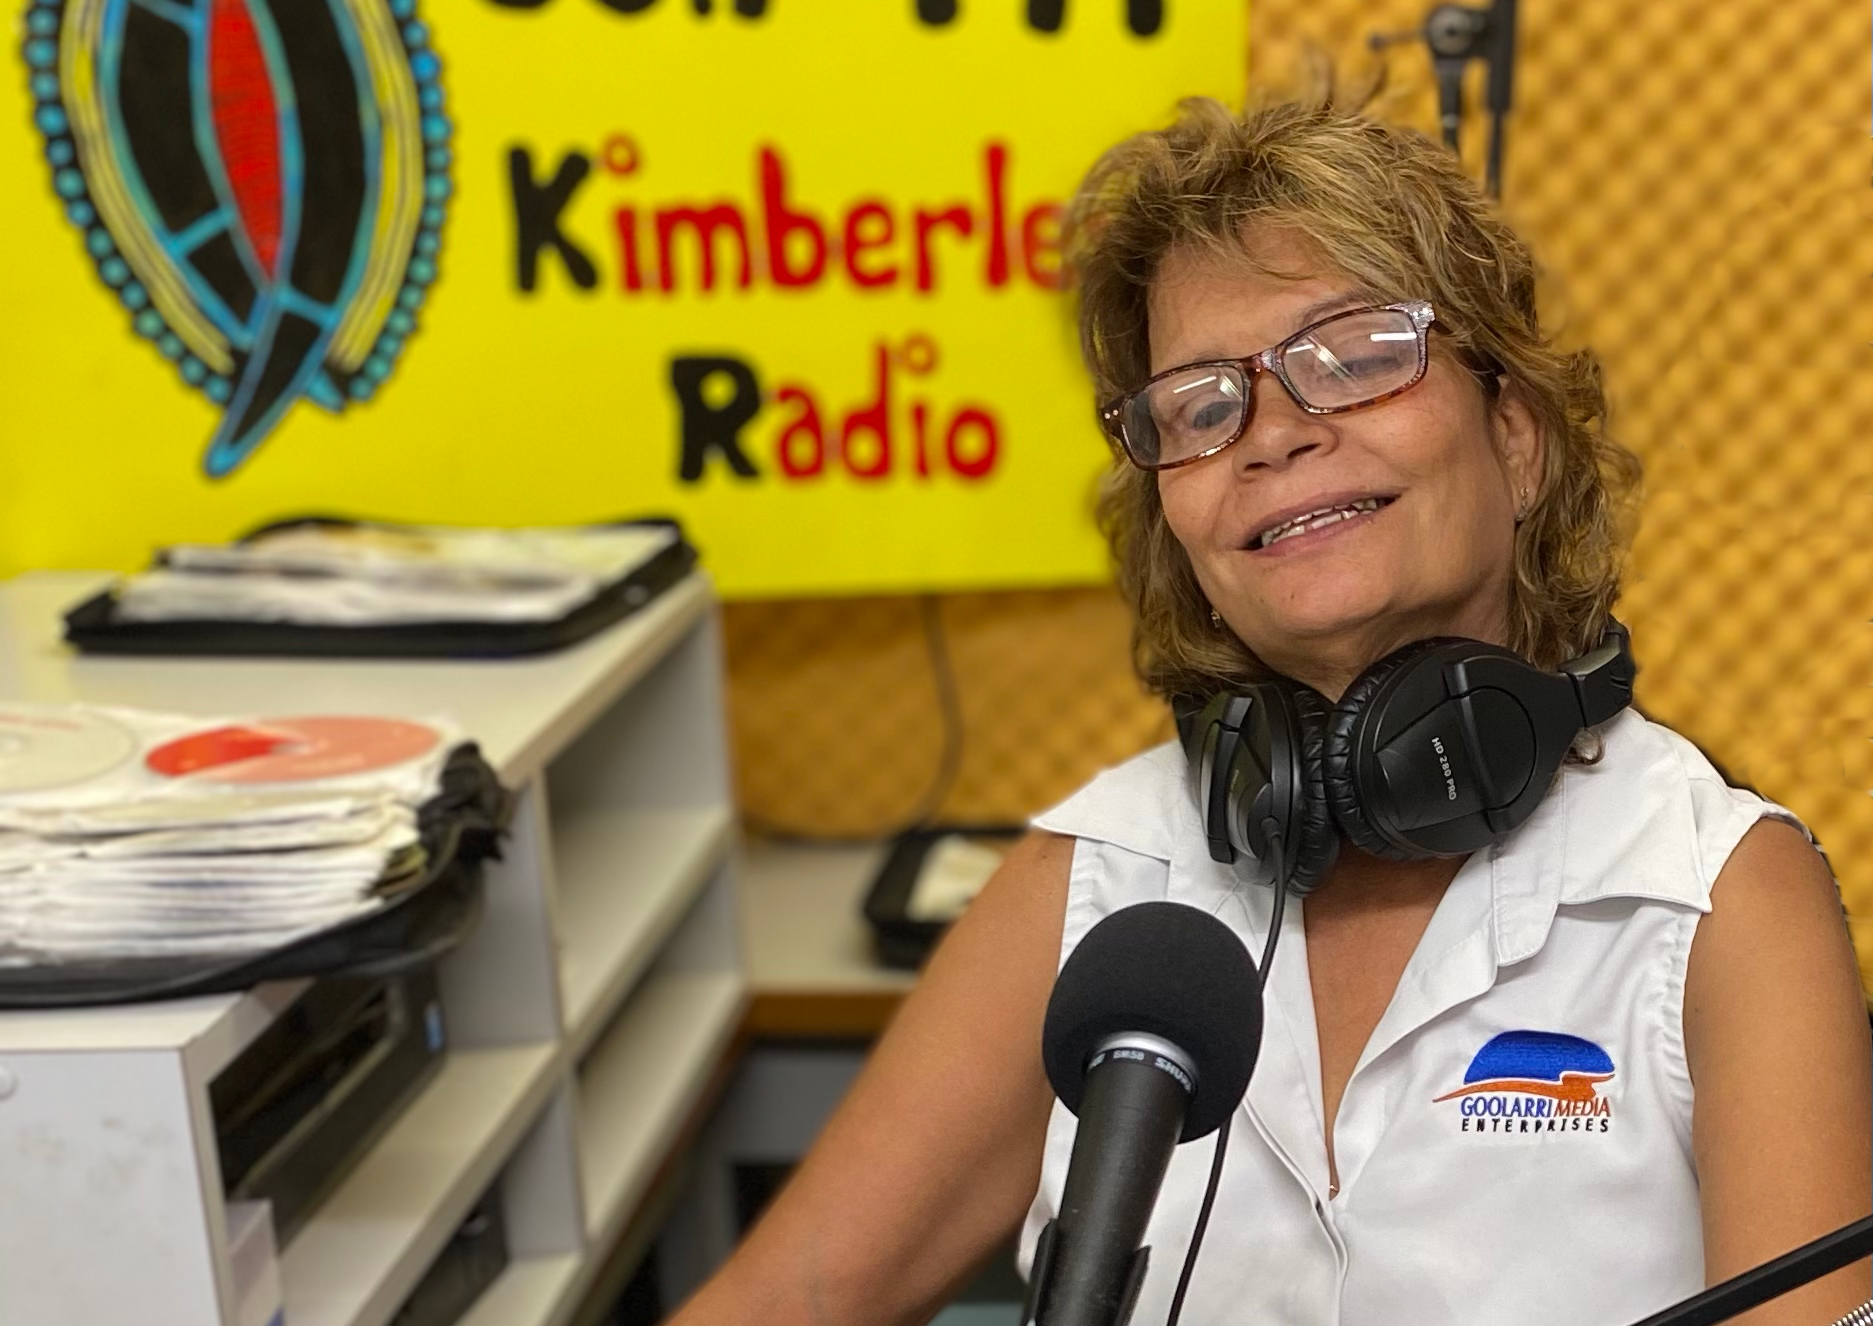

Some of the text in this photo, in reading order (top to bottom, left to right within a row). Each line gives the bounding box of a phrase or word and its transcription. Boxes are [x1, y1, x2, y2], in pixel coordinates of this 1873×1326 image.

[508, 133, 1072, 294] Kimberle
[668, 333, 1003, 484] Radio
[1432, 737, 1457, 800] HD 280 PRO
[1461, 1118, 1610, 1132] ENTERPRISES
